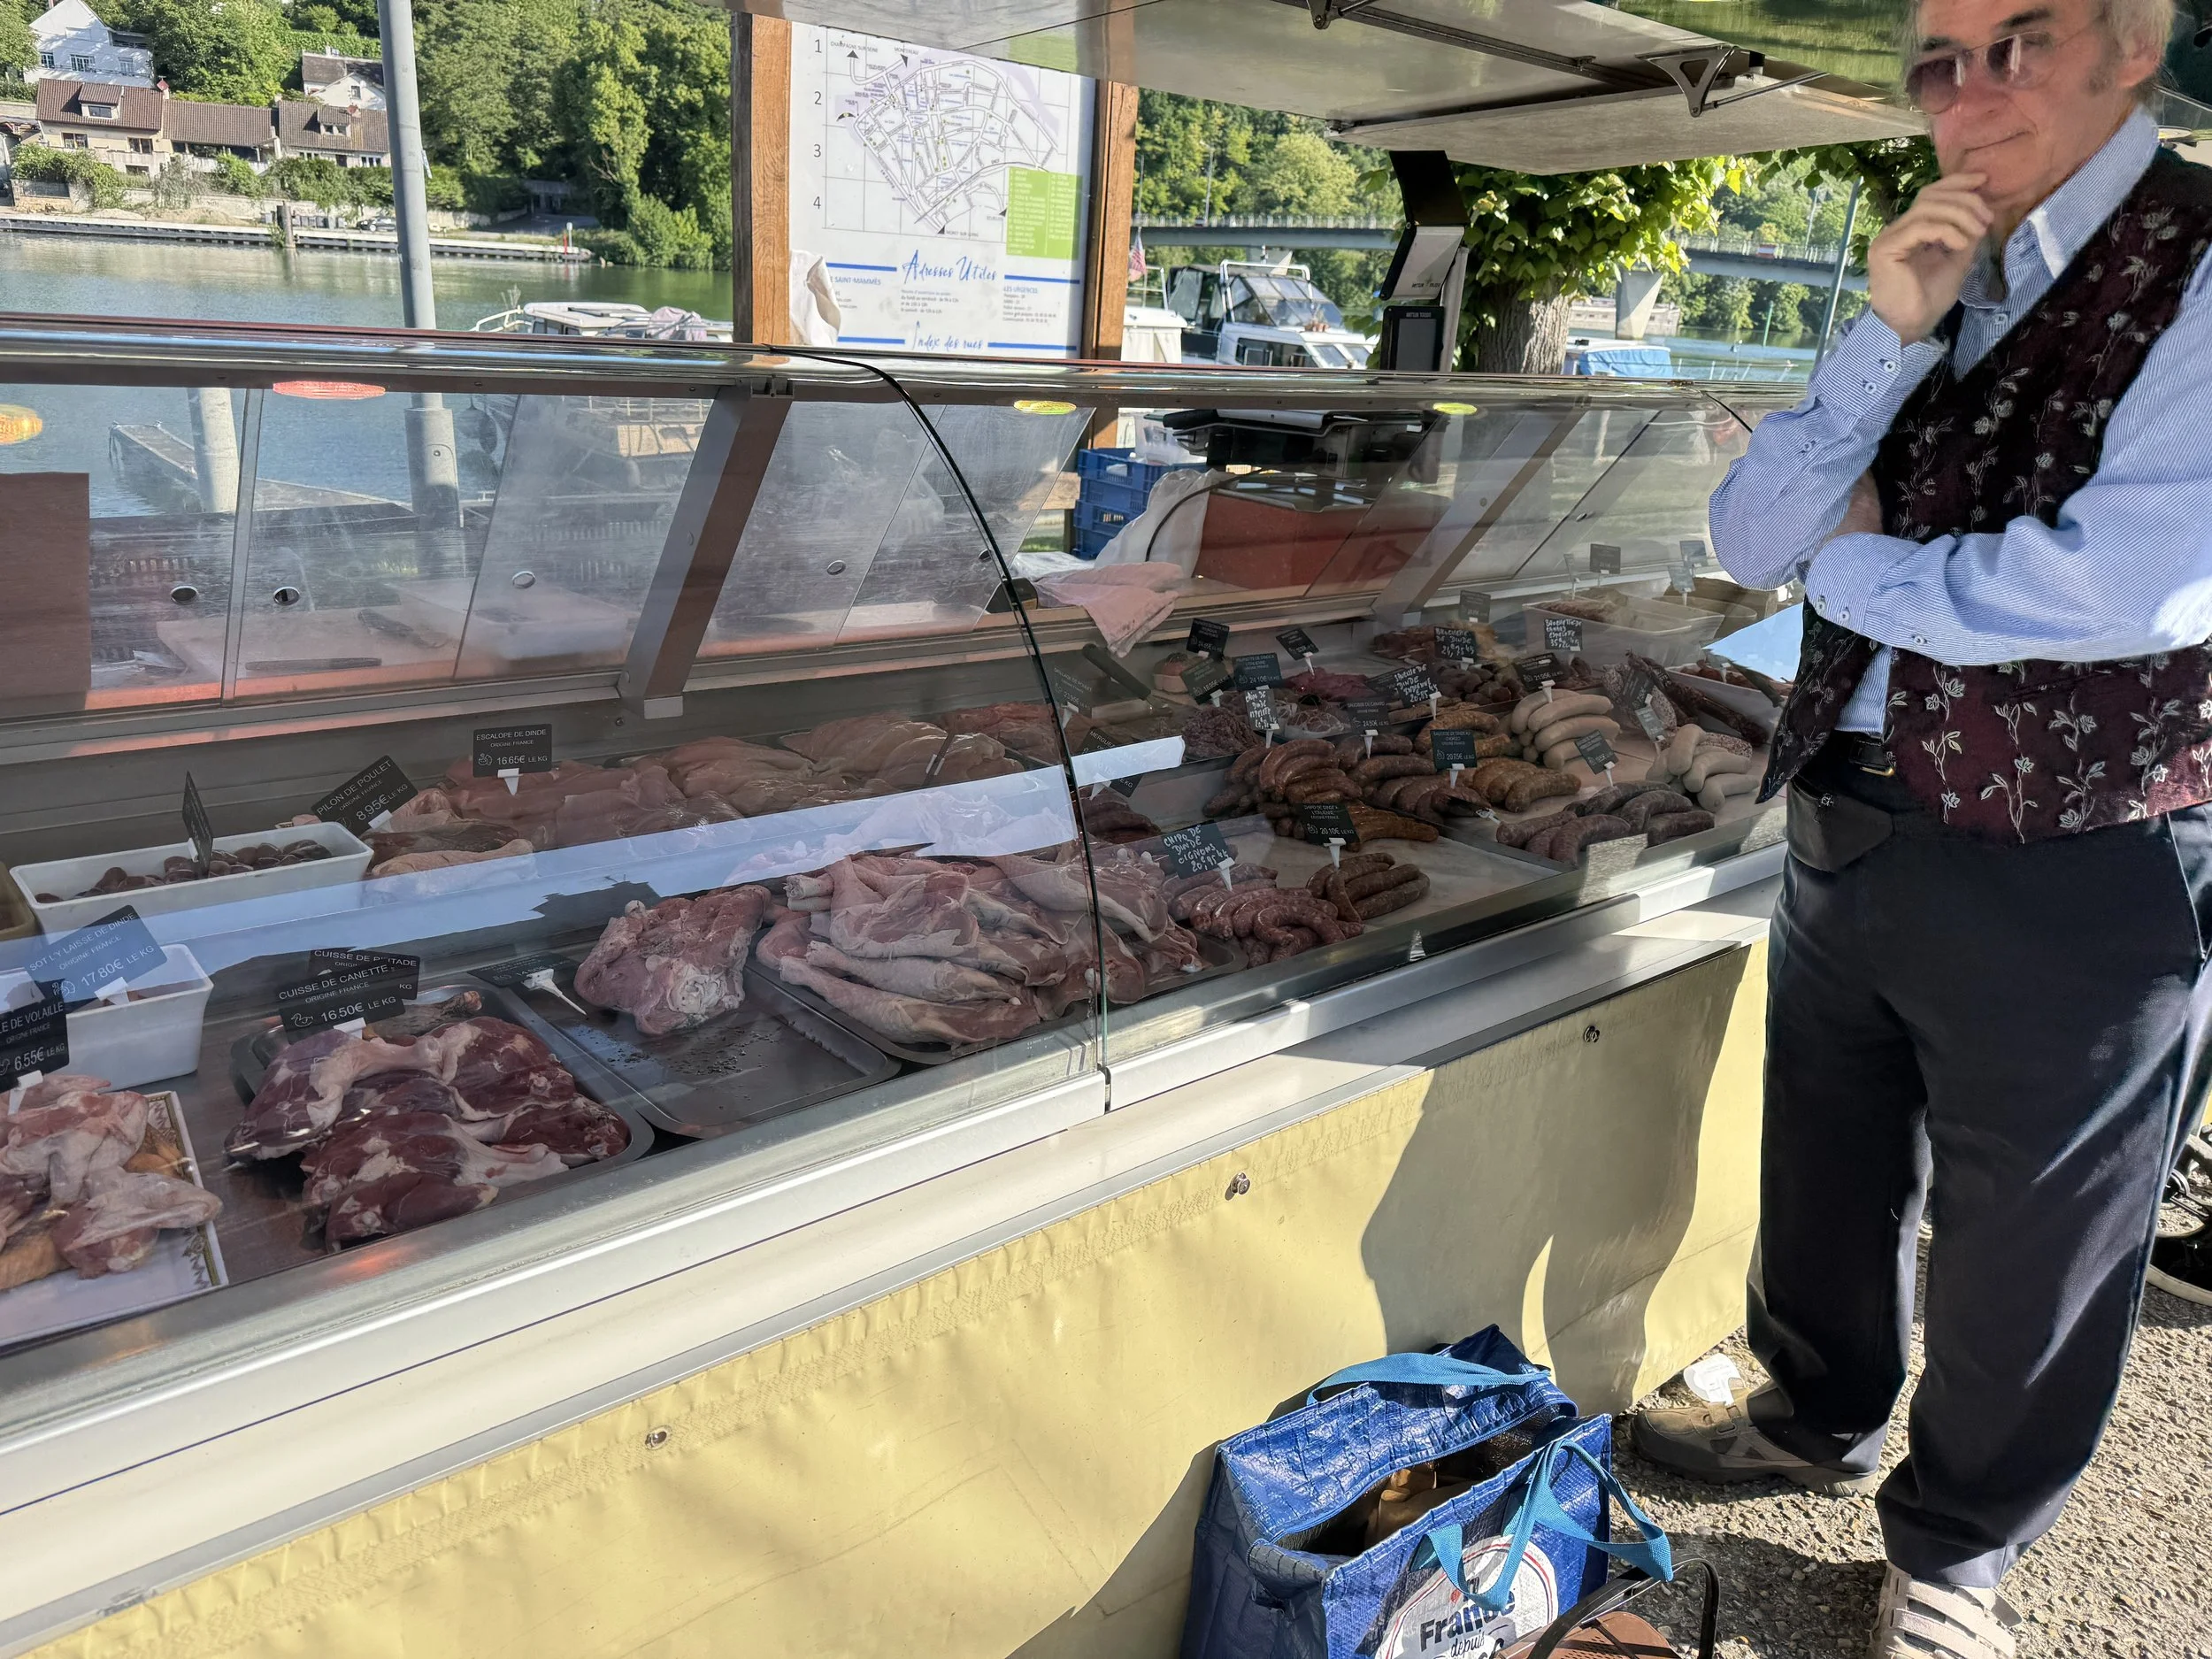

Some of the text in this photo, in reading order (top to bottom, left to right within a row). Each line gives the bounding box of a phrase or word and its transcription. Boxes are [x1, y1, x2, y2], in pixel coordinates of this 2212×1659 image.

[815, 39, 822, 53] 1
[815, 91, 822, 105] 2
[814, 144, 821, 157] 3
[813, 196, 821, 209] 4
[902, 250, 996, 284] Adresses Utiles
[913, 320, 983, 351] Index des rues
[317, 760, 391, 815] PILON DE POULET
[357, 794, 389, 821] 8.95€
[397, 784, 408, 793] KG
[1164, 825, 1202, 847] CHIPO DE
[1171, 835, 1202, 856] DINDE
[30, 958, 49, 972] SOT
[64, 935, 94, 954] LAISSE
[95, 928, 107, 938] DE
[109, 913, 135, 930] DINDE
[91, 936, 121, 953] FRANCE
[127, 953, 139, 964] LE
[140, 946, 155, 957] KG
[314, 949, 353, 960] CUISSE
[373, 956, 417, 967] PTADE
[279, 964, 388, 1000] CUISSE DE CANETTE
[305, 982, 370, 1003] ORIGINE FRANCE
[11, 1016, 23, 1029] DE
[25, 1002, 64, 1024] VOLAILLE
[321, 996, 396, 1022] 16.50€ LE KG
[14, 1043, 65, 1071] 6.55€ LE KG
